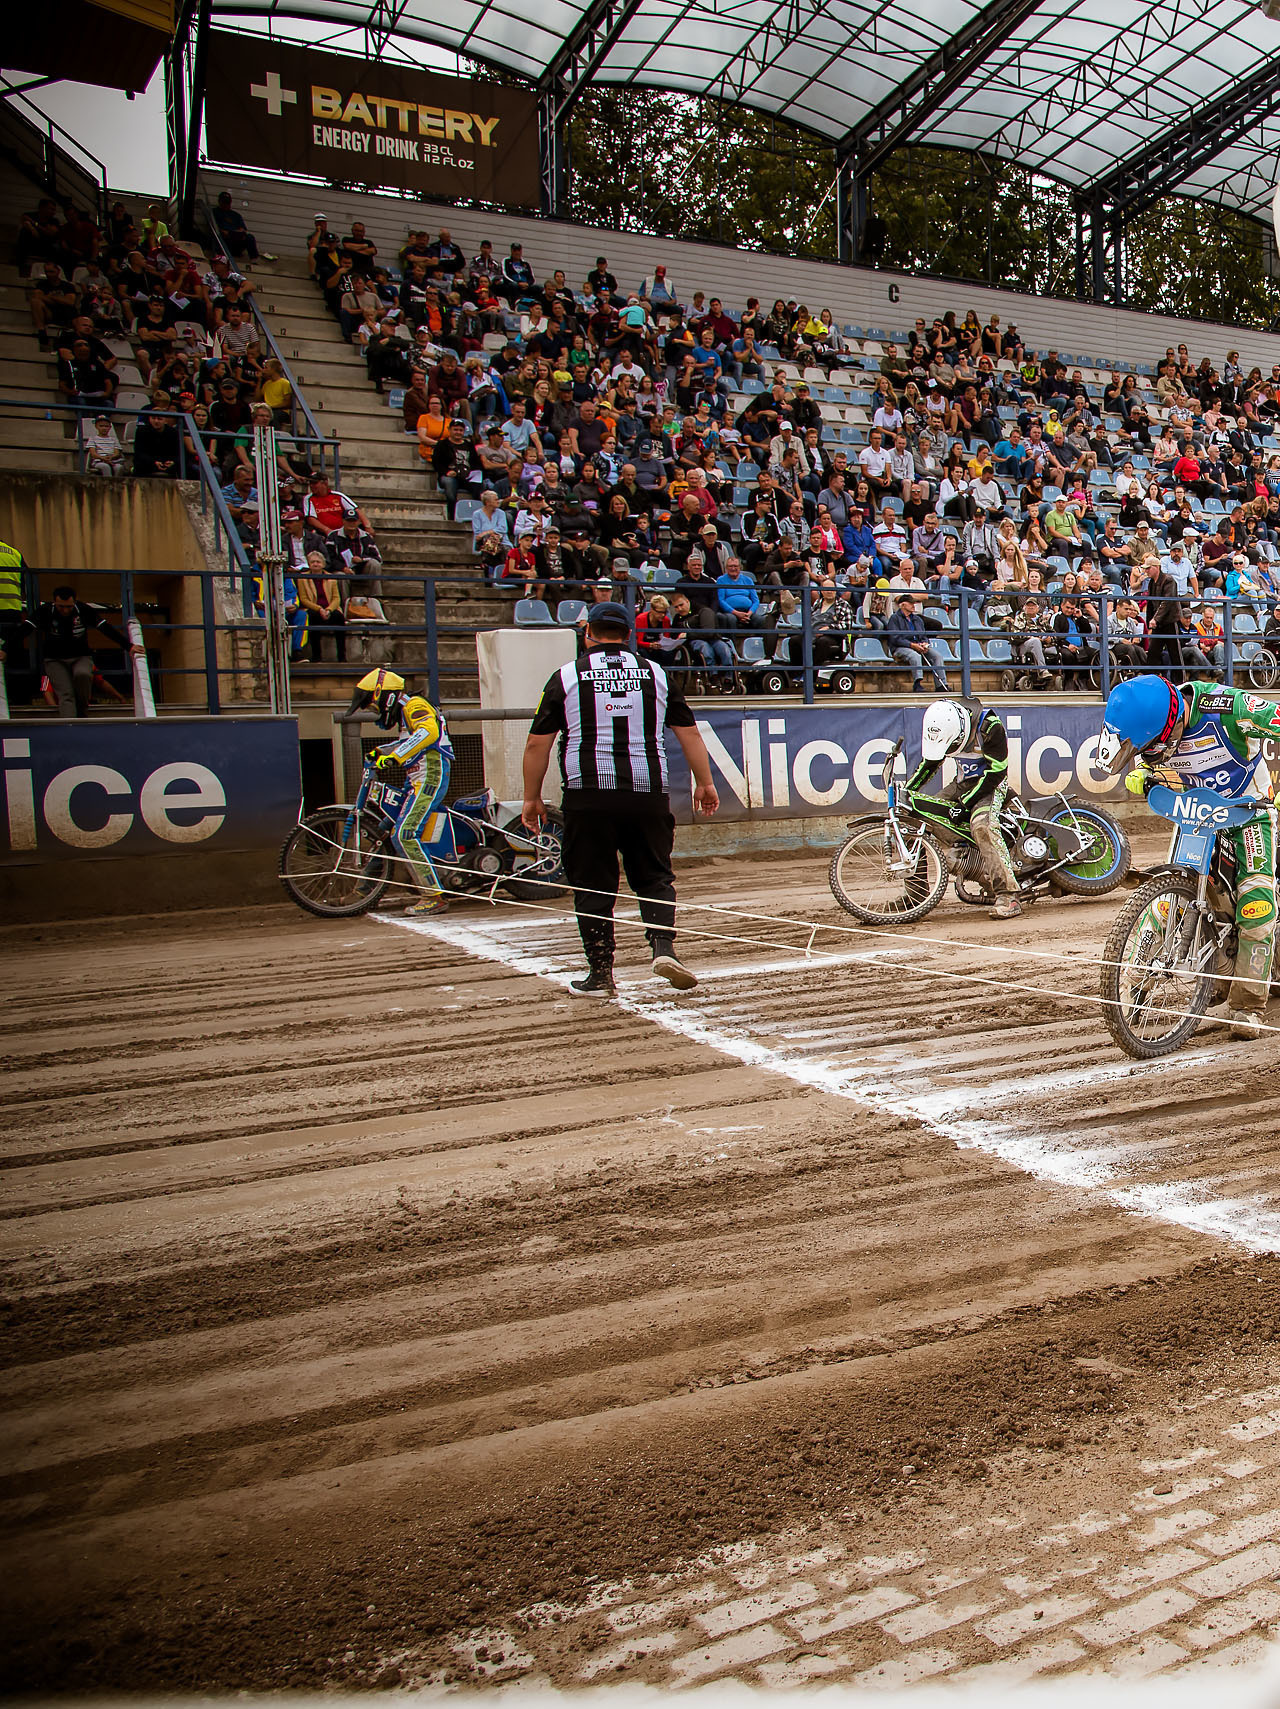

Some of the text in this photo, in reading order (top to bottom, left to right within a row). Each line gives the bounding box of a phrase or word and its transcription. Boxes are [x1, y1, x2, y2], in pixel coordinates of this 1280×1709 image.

[311, 85, 500, 147] BATTERY
[312, 124, 419, 161] ENERGY DRINK
[423, 143, 438, 153] 33
[888, 283, 900, 304] C
[580, 669, 651, 681] KIEROWNIK
[594, 680, 641, 692] STARTU
[691, 718, 907, 811] Nice
[1172, 795, 1229, 823] Nice
[1253, 824, 1263, 856] DAWID
